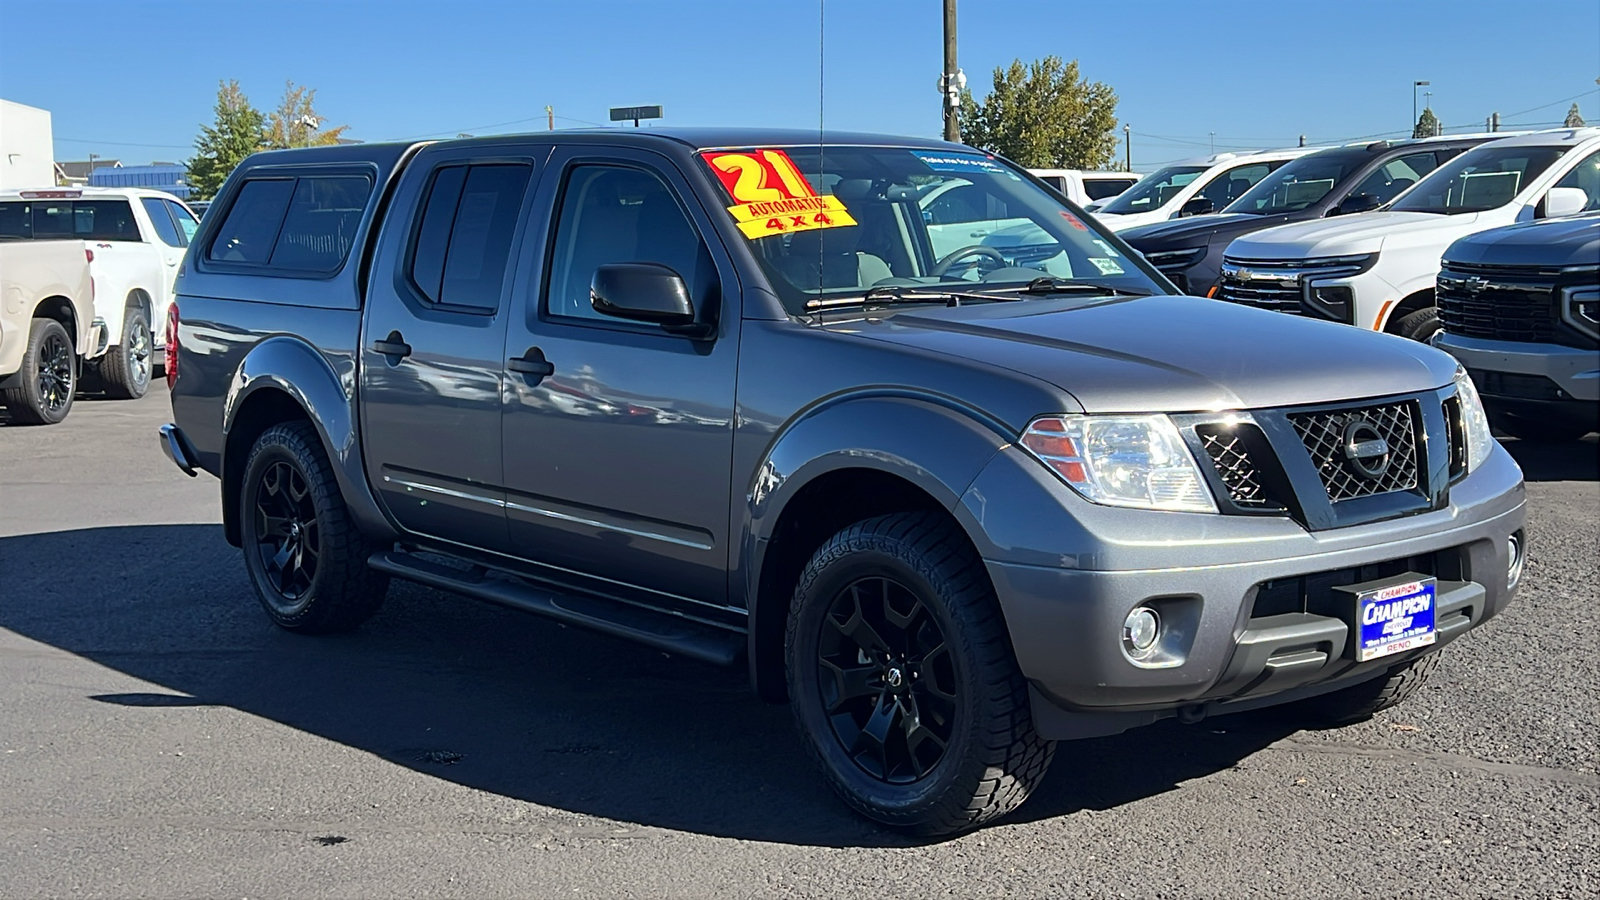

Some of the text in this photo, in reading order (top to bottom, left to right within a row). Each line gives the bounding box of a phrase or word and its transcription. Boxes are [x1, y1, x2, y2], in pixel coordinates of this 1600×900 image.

[711, 150, 809, 202] 21
[747, 197, 828, 217] AUTOMATIC
[1380, 584, 1418, 600] CHAMPION
[1362, 593, 1432, 626] CHAMPION
[1386, 640, 1412, 653] RENO
